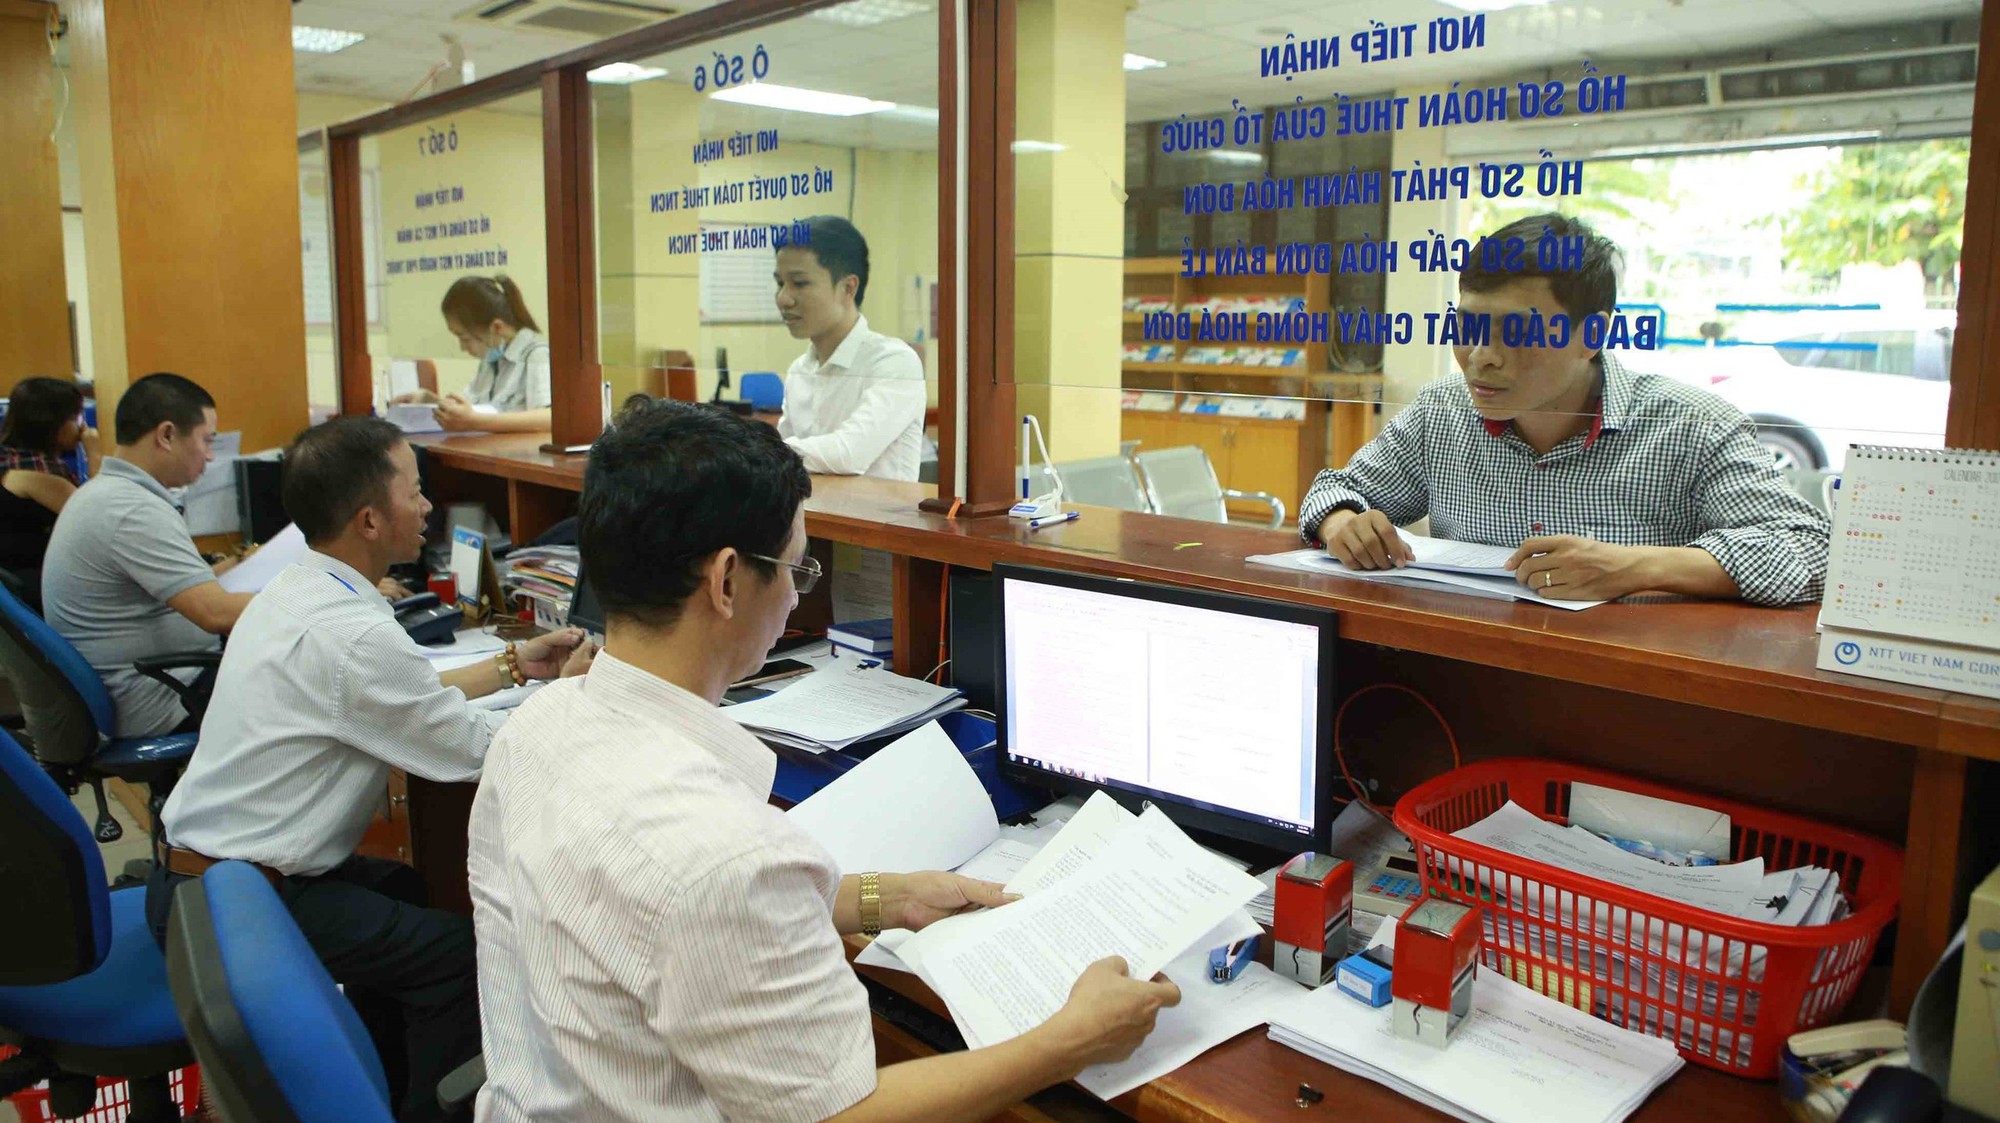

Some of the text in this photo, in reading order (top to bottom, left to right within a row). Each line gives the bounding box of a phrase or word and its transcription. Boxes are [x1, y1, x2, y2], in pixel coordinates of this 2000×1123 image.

[1869, 647, 1894, 659] NTT
[1899, 650, 1928, 665] VIET
[1932, 657, 1964, 670] NAM
